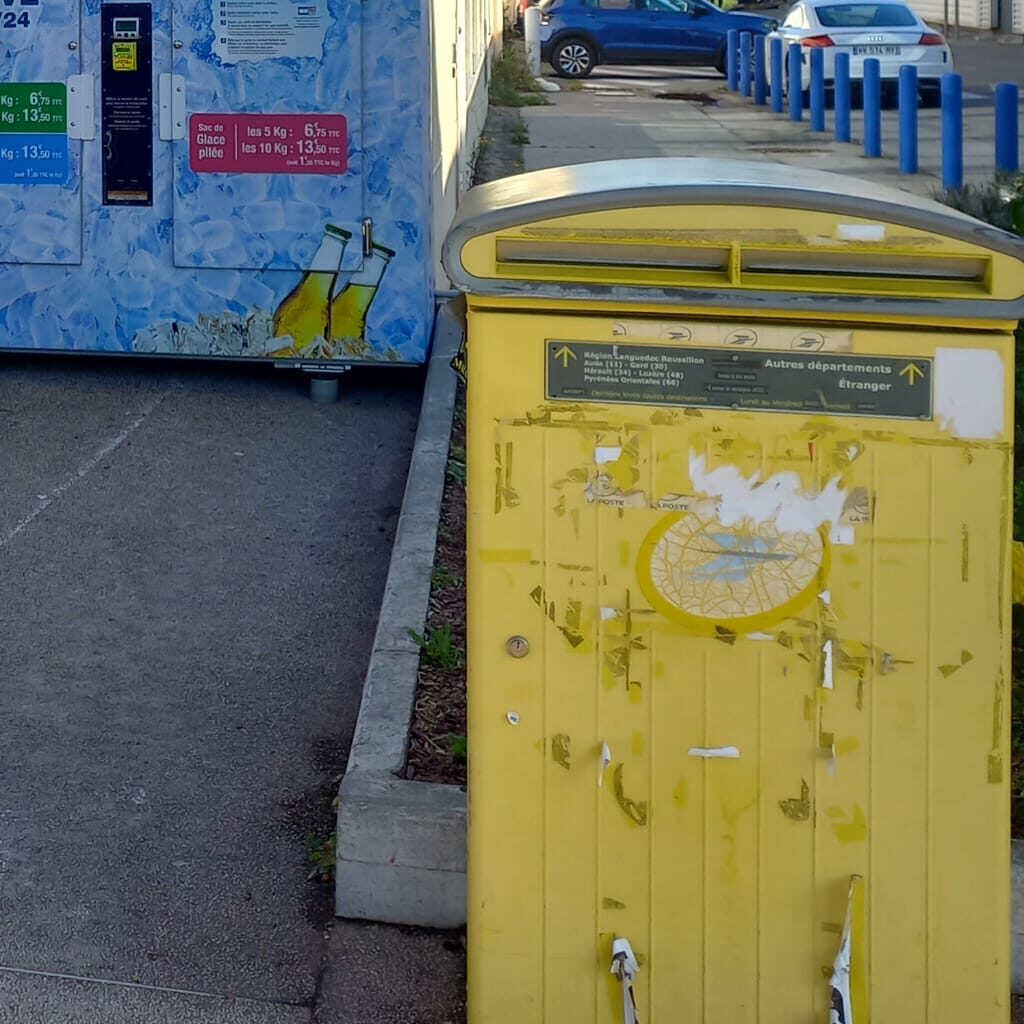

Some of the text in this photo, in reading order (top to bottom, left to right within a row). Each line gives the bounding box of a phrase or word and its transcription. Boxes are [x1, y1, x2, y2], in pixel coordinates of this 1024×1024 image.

[1, 95, 14, 107] Kg
[2, 112, 15, 124] Kg
[198, 123, 224, 132] Sac de
[247, 126, 263, 137] les
[264, 126, 272, 137] 5
[273, 126, 287, 139] Kg
[196, 134, 226, 145] Glace
[1, 148, 14, 160] Kg
[198, 147, 224, 160] pilée
[241, 143, 258, 154] les
[260, 143, 272, 154] 10
[274, 143, 288, 155] Kg
[661, 355, 705, 365] Roussillon
[765, 359, 892, 374] Autres départements
[839, 377, 892, 392] Étranger
[598, 498, 625, 506] POSTE
[662, 503, 689, 511] POSTE
